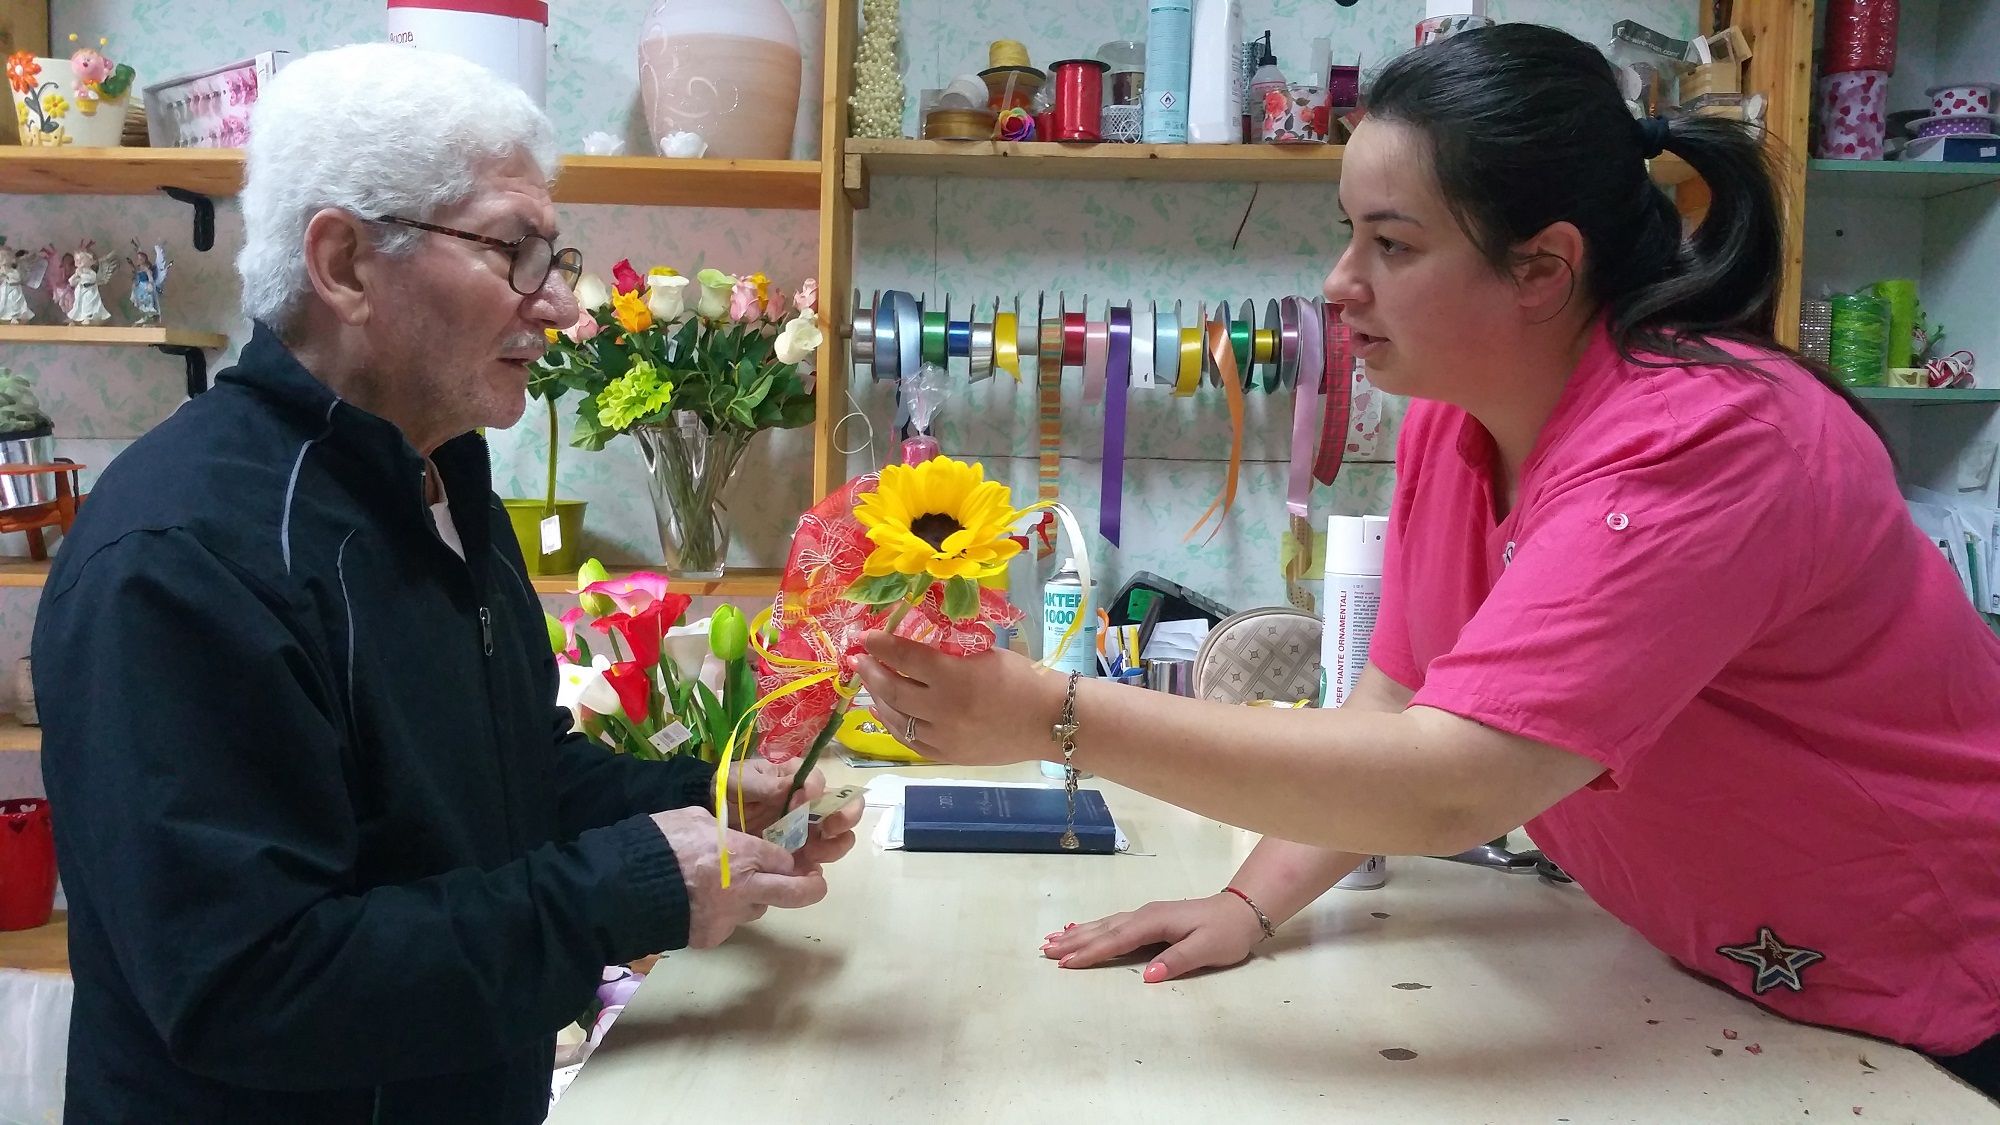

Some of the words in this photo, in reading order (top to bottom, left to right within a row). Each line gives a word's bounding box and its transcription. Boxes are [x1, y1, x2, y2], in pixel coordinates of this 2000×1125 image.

[1045, 609, 1076, 624] 1000
[1338, 590, 1347, 652] ORNAMENTALI
[1337, 654, 1345, 685] PIANTE
[1336, 686, 1344, 704] PER
